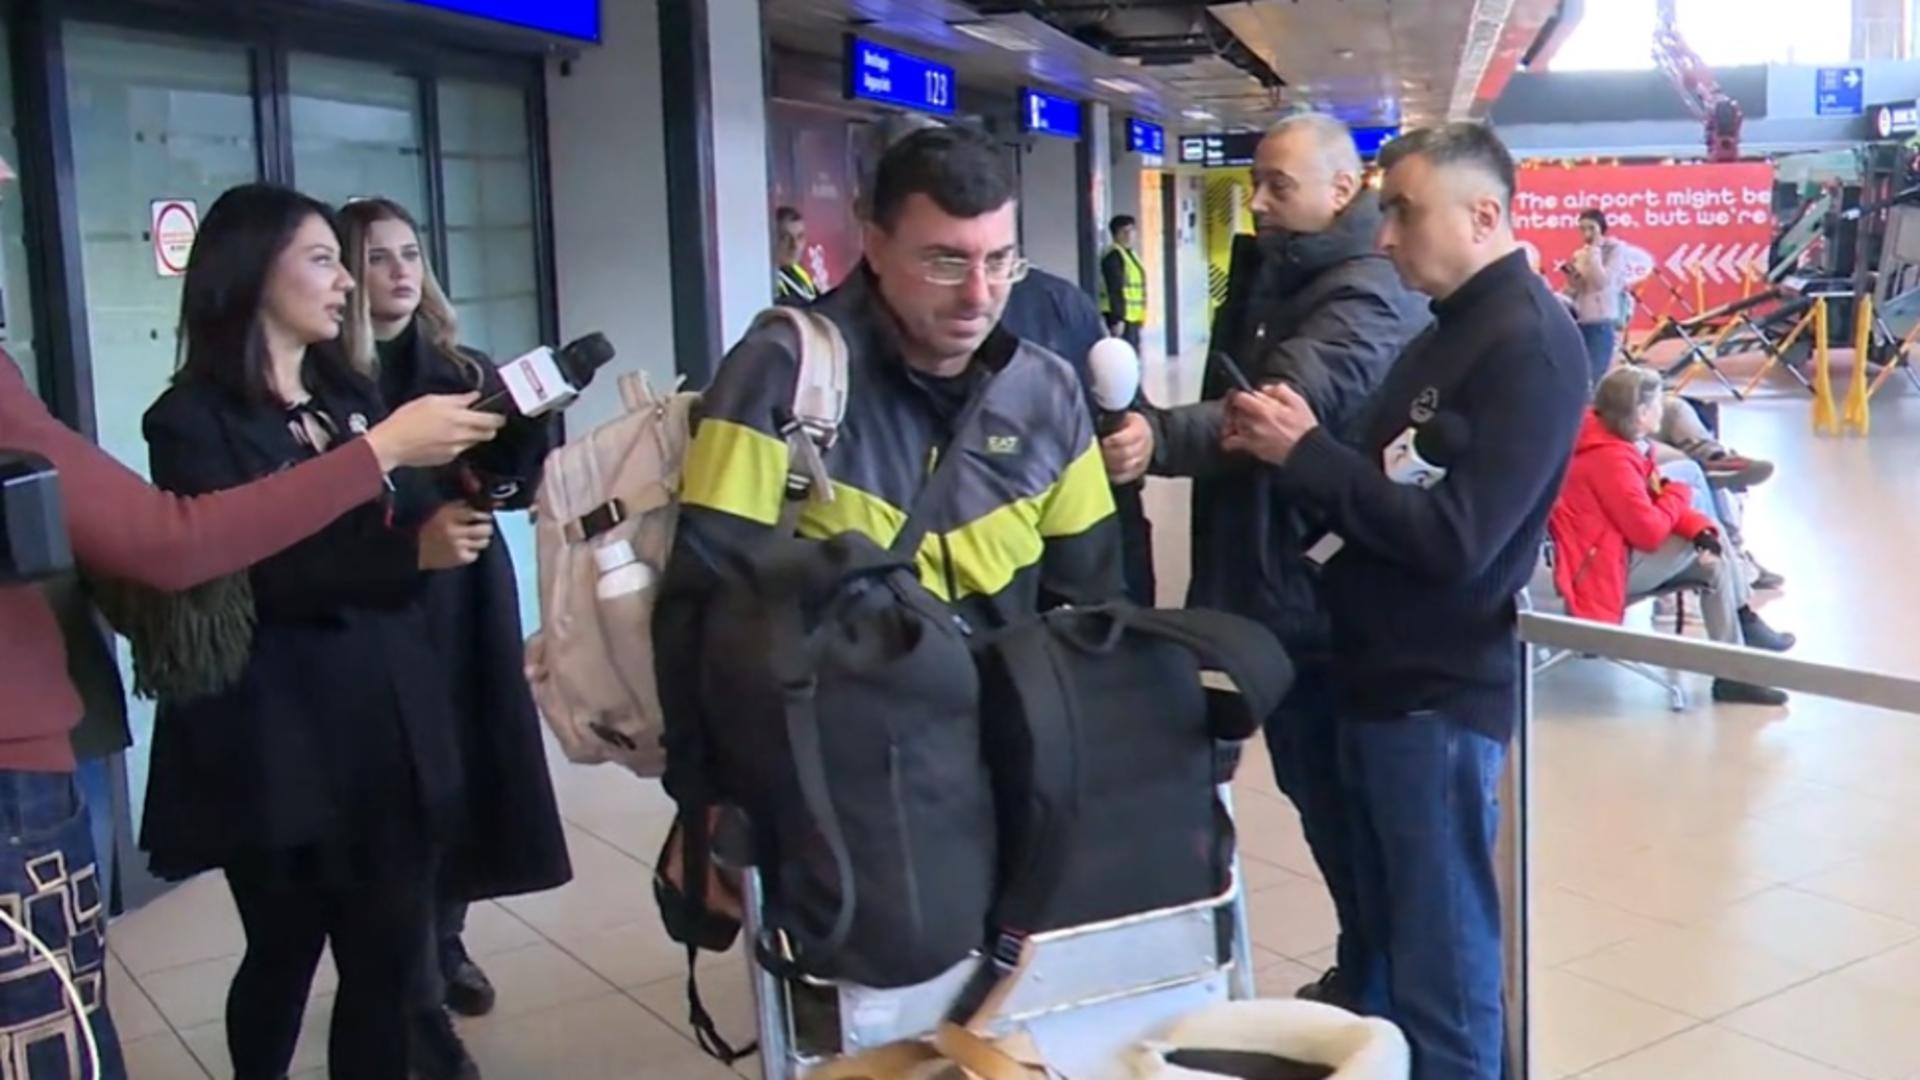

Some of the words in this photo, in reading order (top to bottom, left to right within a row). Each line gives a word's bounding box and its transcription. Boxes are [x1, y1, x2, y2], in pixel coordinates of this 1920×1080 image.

[925, 70, 948, 106] 123
[1514, 191, 1558, 210] The
[1563, 189, 1661, 212] airport
[1665, 187, 1737, 209] might
[1741, 186, 1772, 205] be
[1645, 208, 1692, 227] but
[1695, 206, 1768, 227] we're
